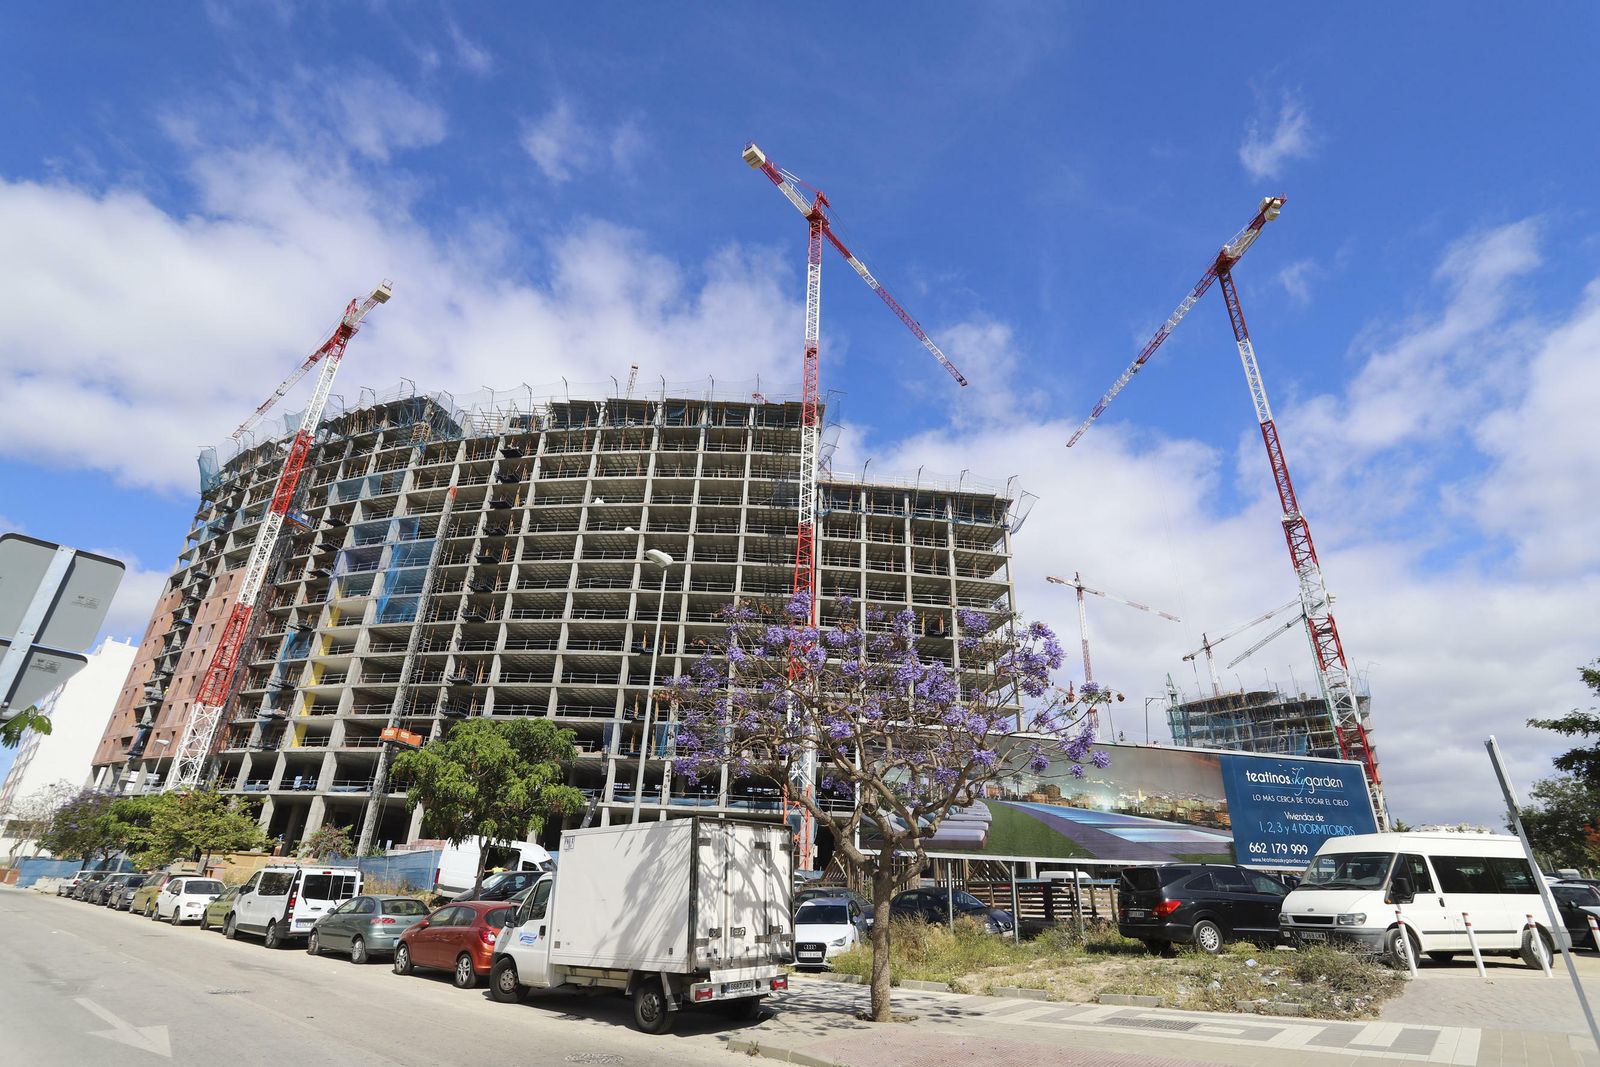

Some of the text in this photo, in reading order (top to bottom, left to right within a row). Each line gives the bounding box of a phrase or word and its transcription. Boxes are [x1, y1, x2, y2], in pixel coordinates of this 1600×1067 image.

[1252, 793, 1261, 801] LO
[1276, 795, 1295, 803] CERCA
[1296, 796, 1303, 804] DE
[1305, 797, 1324, 805] TOCAR
[1325, 798, 1331, 806] EL
[1333, 799, 1349, 807] CIELO
[1284, 811, 1325, 822] Viviendas de
[1298, 823, 1355, 836] DORMITORIOS
[1249, 842, 1308, 855] 662 179 999
